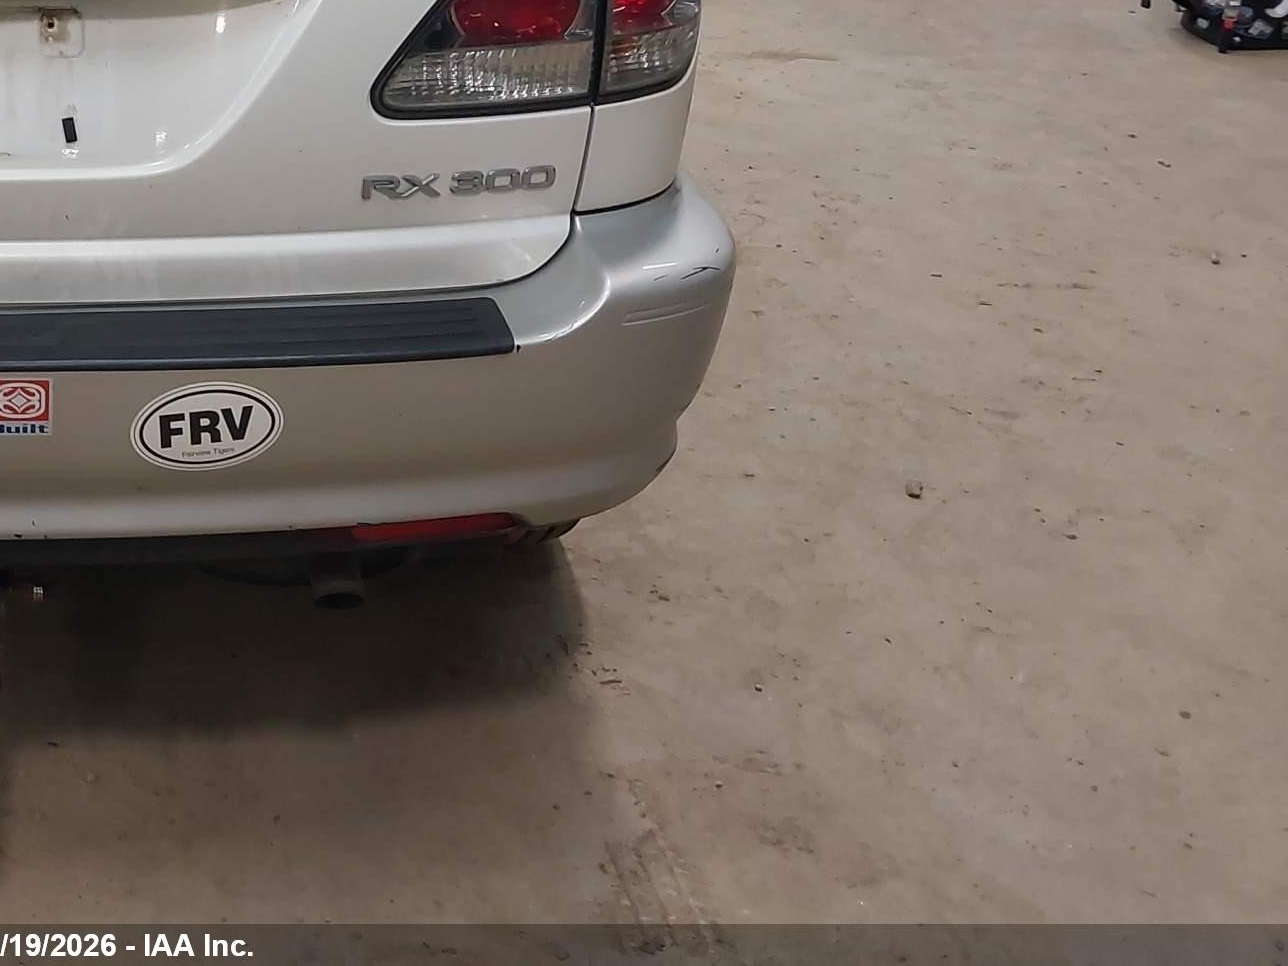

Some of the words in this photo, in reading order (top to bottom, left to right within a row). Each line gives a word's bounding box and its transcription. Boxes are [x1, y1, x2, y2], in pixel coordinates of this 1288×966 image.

[361, 172, 441, 201] RX
[449, 164, 557, 197] 300
[158, 405, 254, 449] FRV
